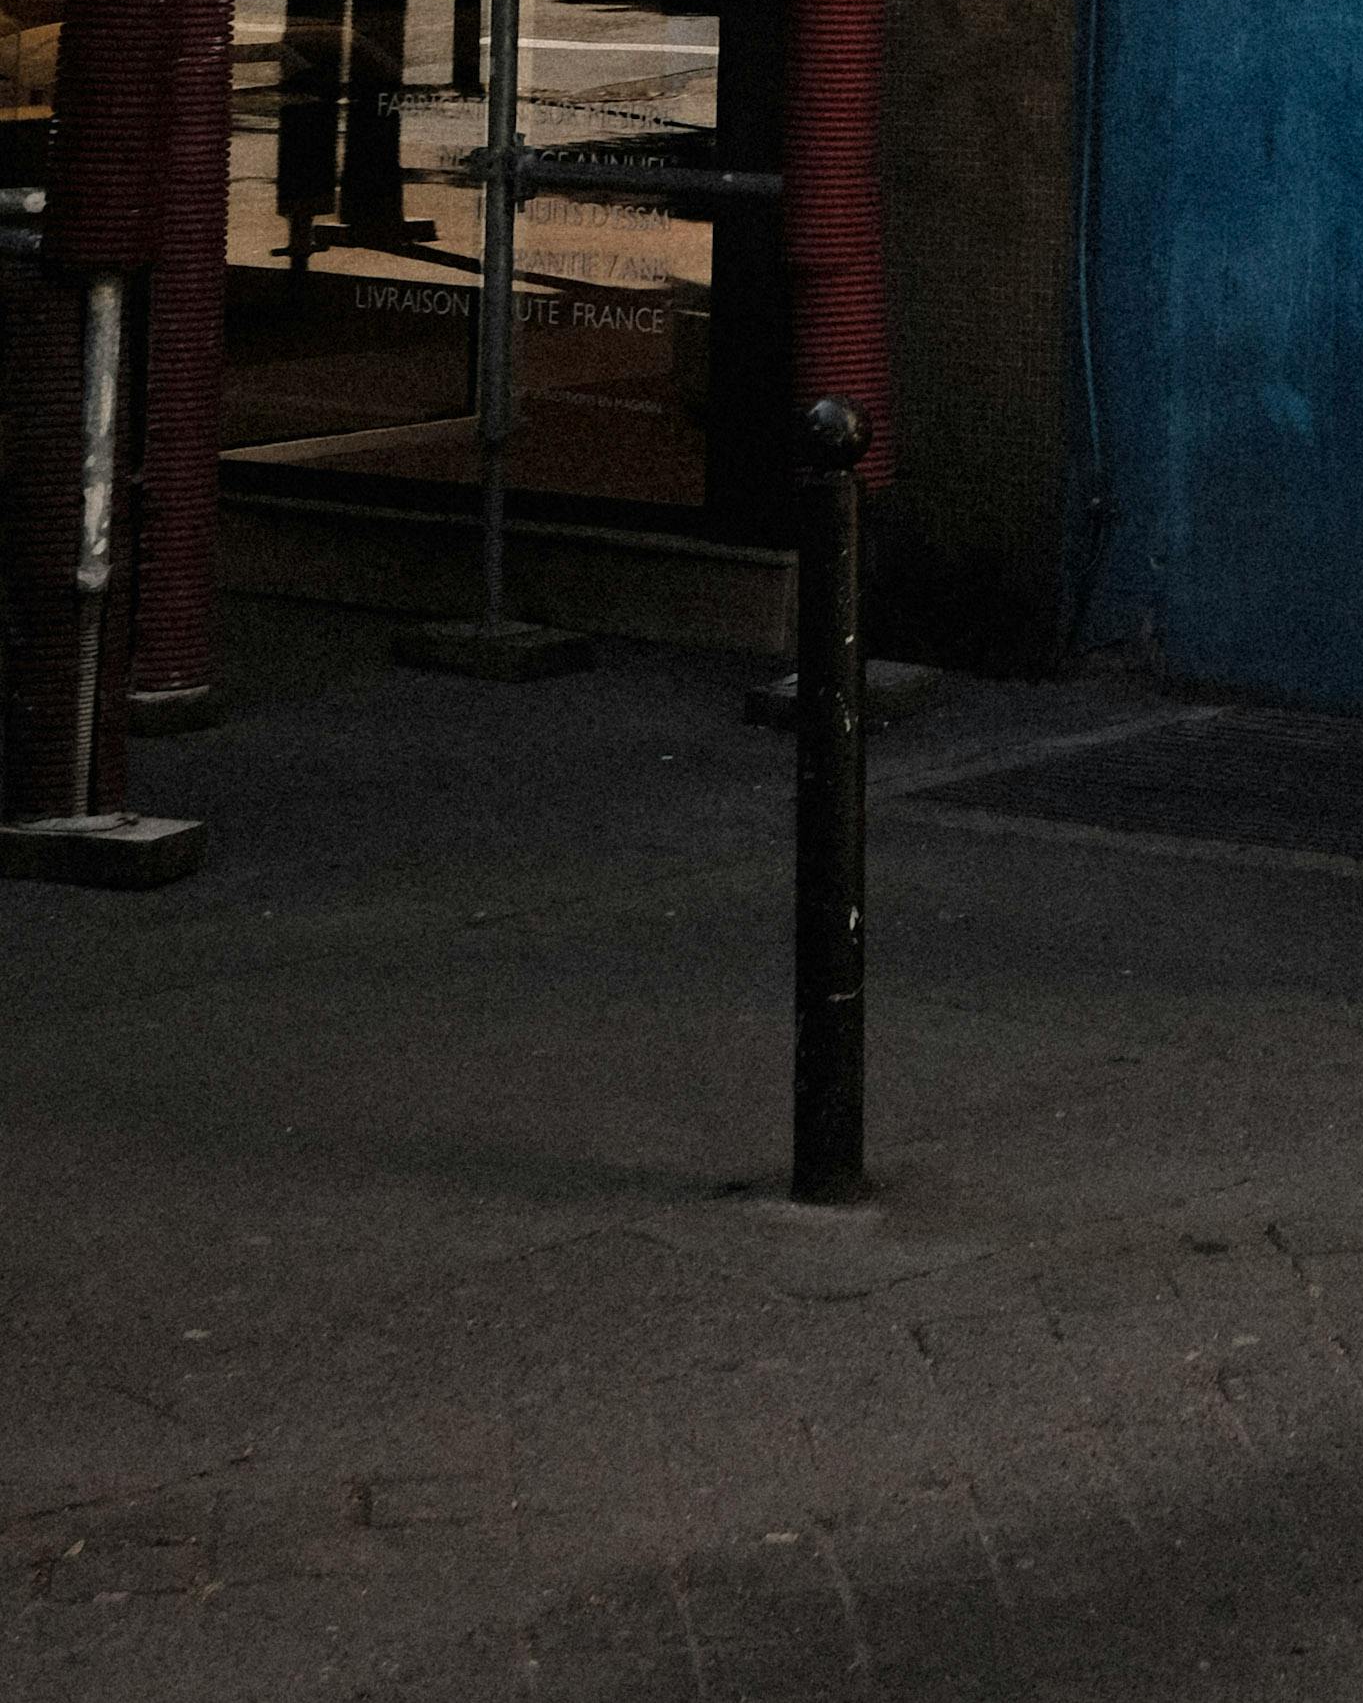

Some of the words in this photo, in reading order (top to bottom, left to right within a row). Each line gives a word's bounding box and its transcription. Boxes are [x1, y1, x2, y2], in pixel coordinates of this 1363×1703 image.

[354, 285, 471, 318] LIVRAISON
[515, 298, 560, 326] UTE
[572, 300, 665, 335] FRANCE
